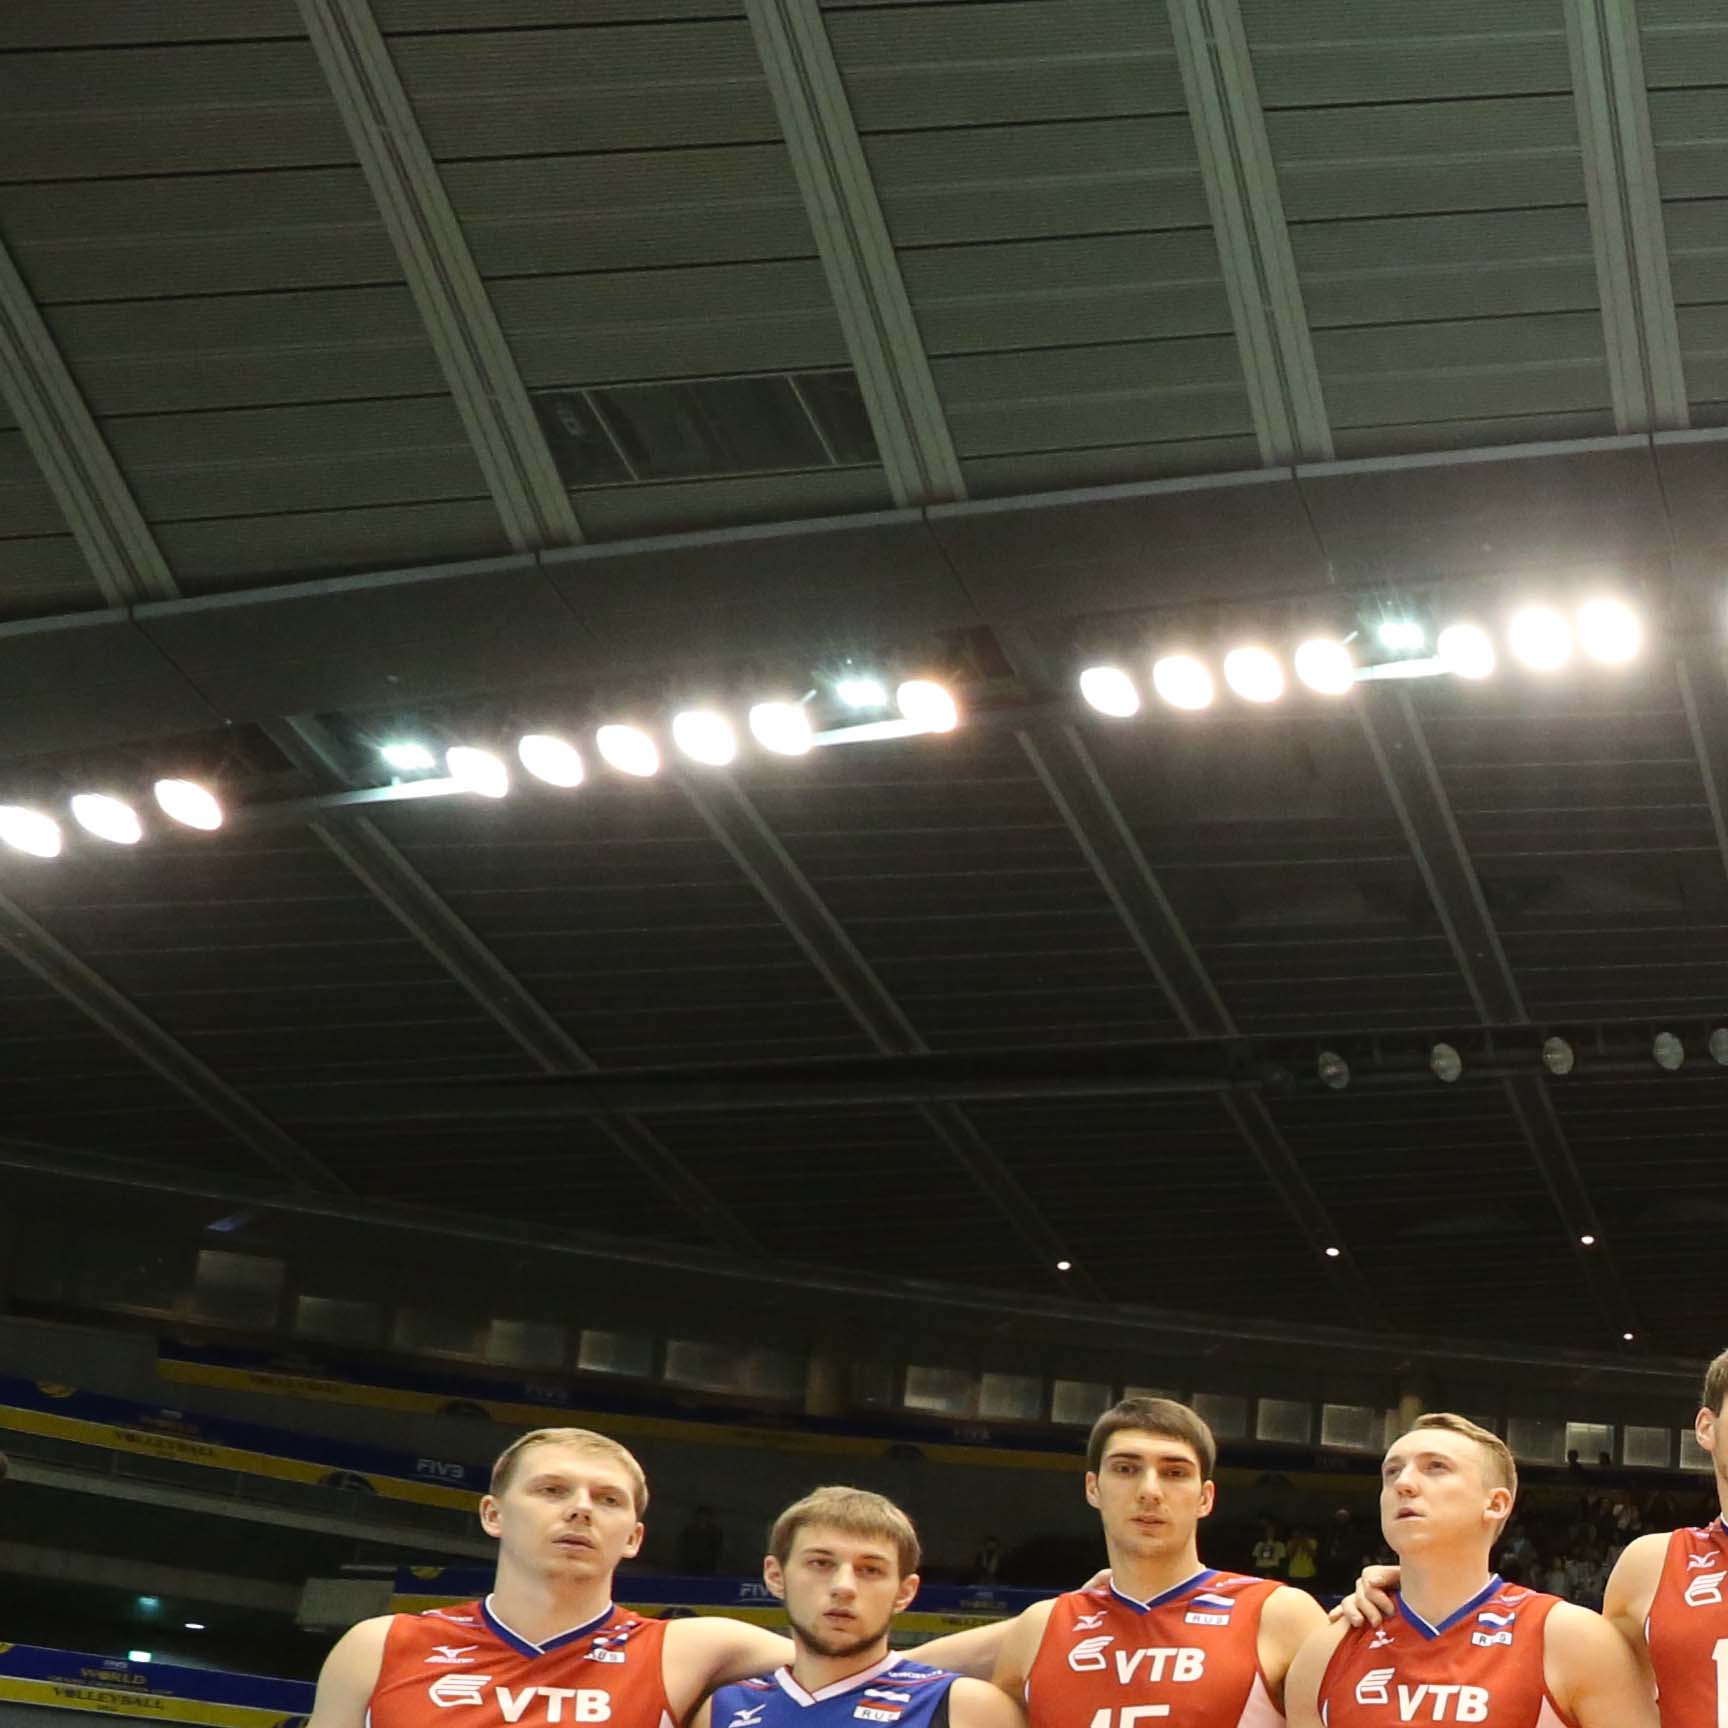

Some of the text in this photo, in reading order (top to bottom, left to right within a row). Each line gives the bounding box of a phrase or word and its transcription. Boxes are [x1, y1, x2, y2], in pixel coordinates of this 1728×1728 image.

[418, 1458, 464, 1479] FIVB
[1115, 1648, 1206, 1684] VTB
[495, 1686, 612, 1723] VTB
[1397, 1684, 1489, 1722] VTB
